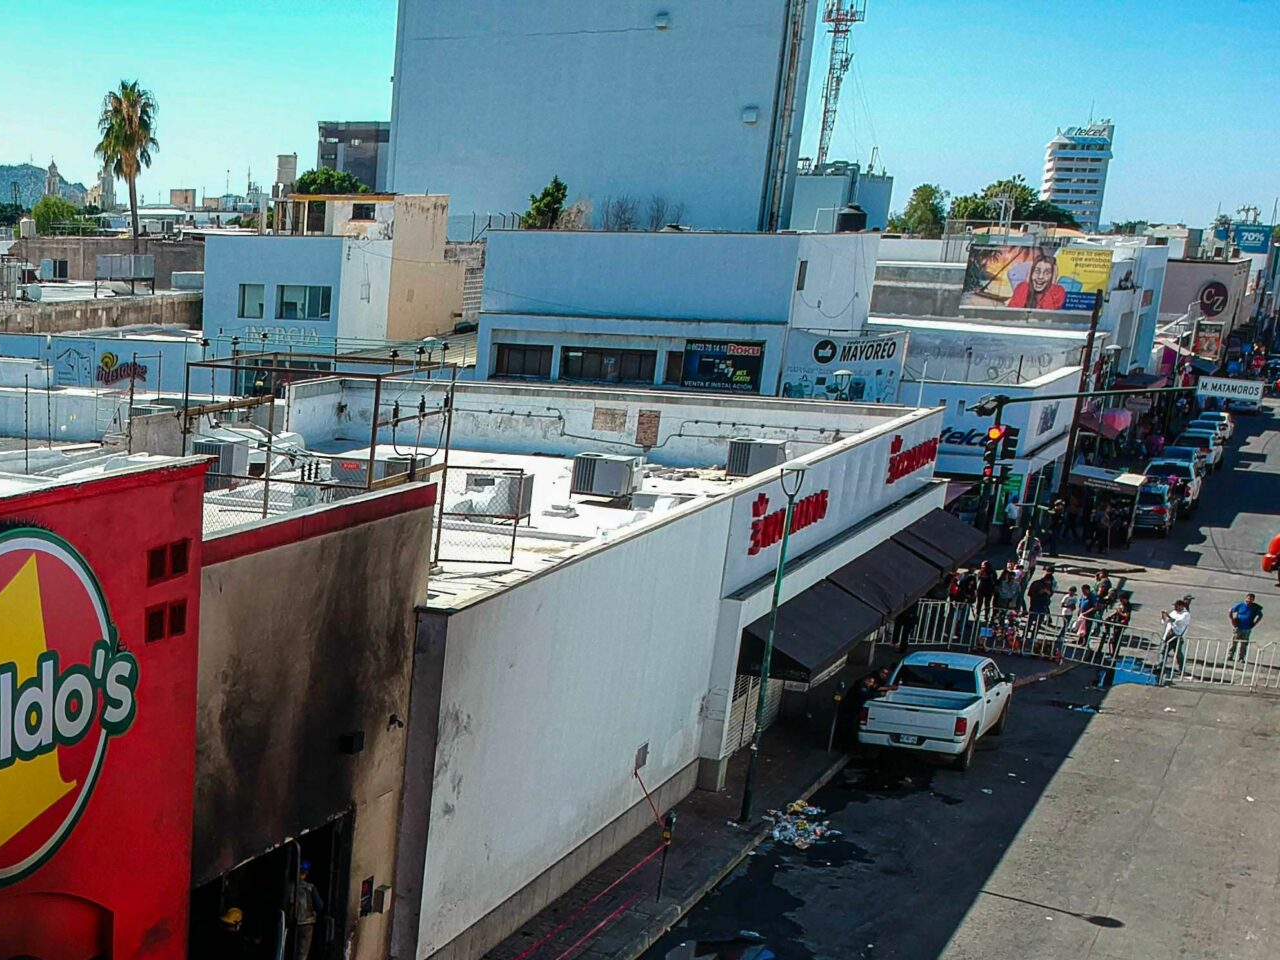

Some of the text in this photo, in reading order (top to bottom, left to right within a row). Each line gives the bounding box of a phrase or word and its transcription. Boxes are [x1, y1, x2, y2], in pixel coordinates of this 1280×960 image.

[1241, 232, 1265, 242] 70%
[245, 326, 320, 346] INERCIA
[839, 341, 896, 362] MAYOREO
[1200, 382, 1260, 396] M. MATAMOROS
